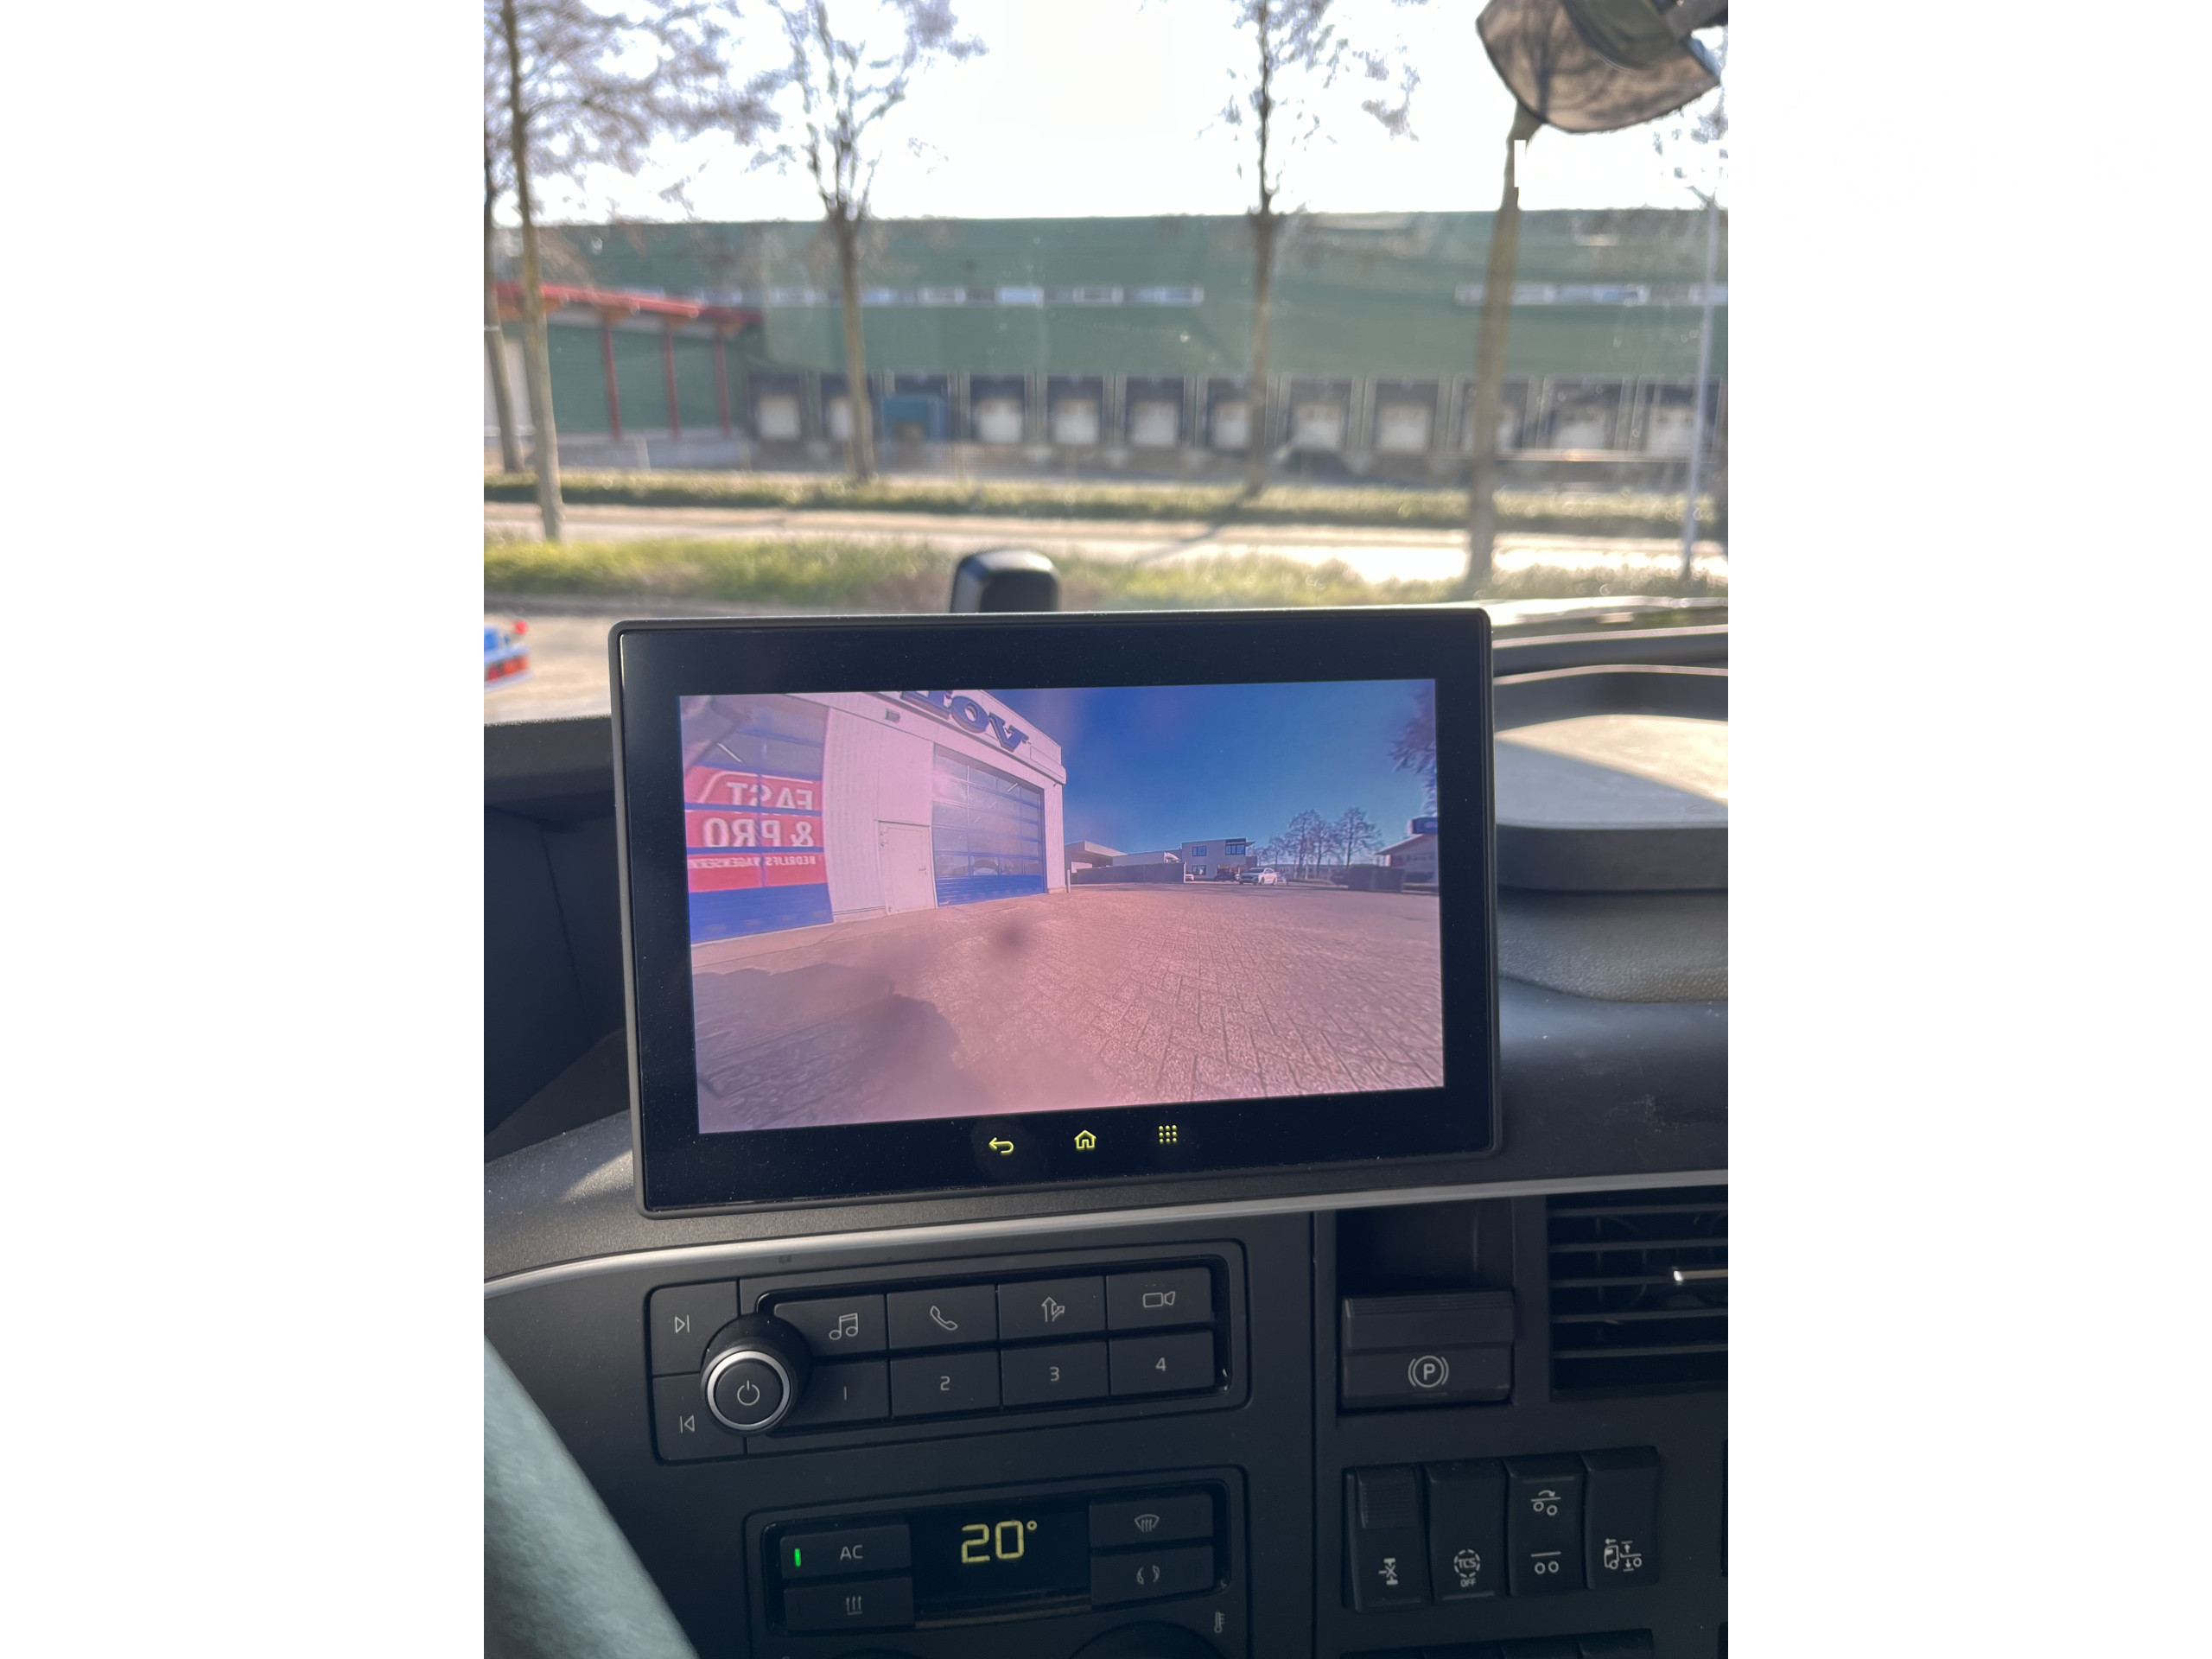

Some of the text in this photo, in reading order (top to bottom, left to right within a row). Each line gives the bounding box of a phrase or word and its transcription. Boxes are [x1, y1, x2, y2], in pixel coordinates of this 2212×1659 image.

[1155, 1357, 1166, 1372] 4
[1422, 1363, 1436, 1381] P
[1049, 1366, 1060, 1382] 3
[939, 1375, 950, 1391] 2
[960, 1519, 1038, 1564] 20°
[839, 1543, 863, 1561] AC
[1458, 1557, 1477, 1569] TCS
[1460, 1577, 1477, 1587] OFF
